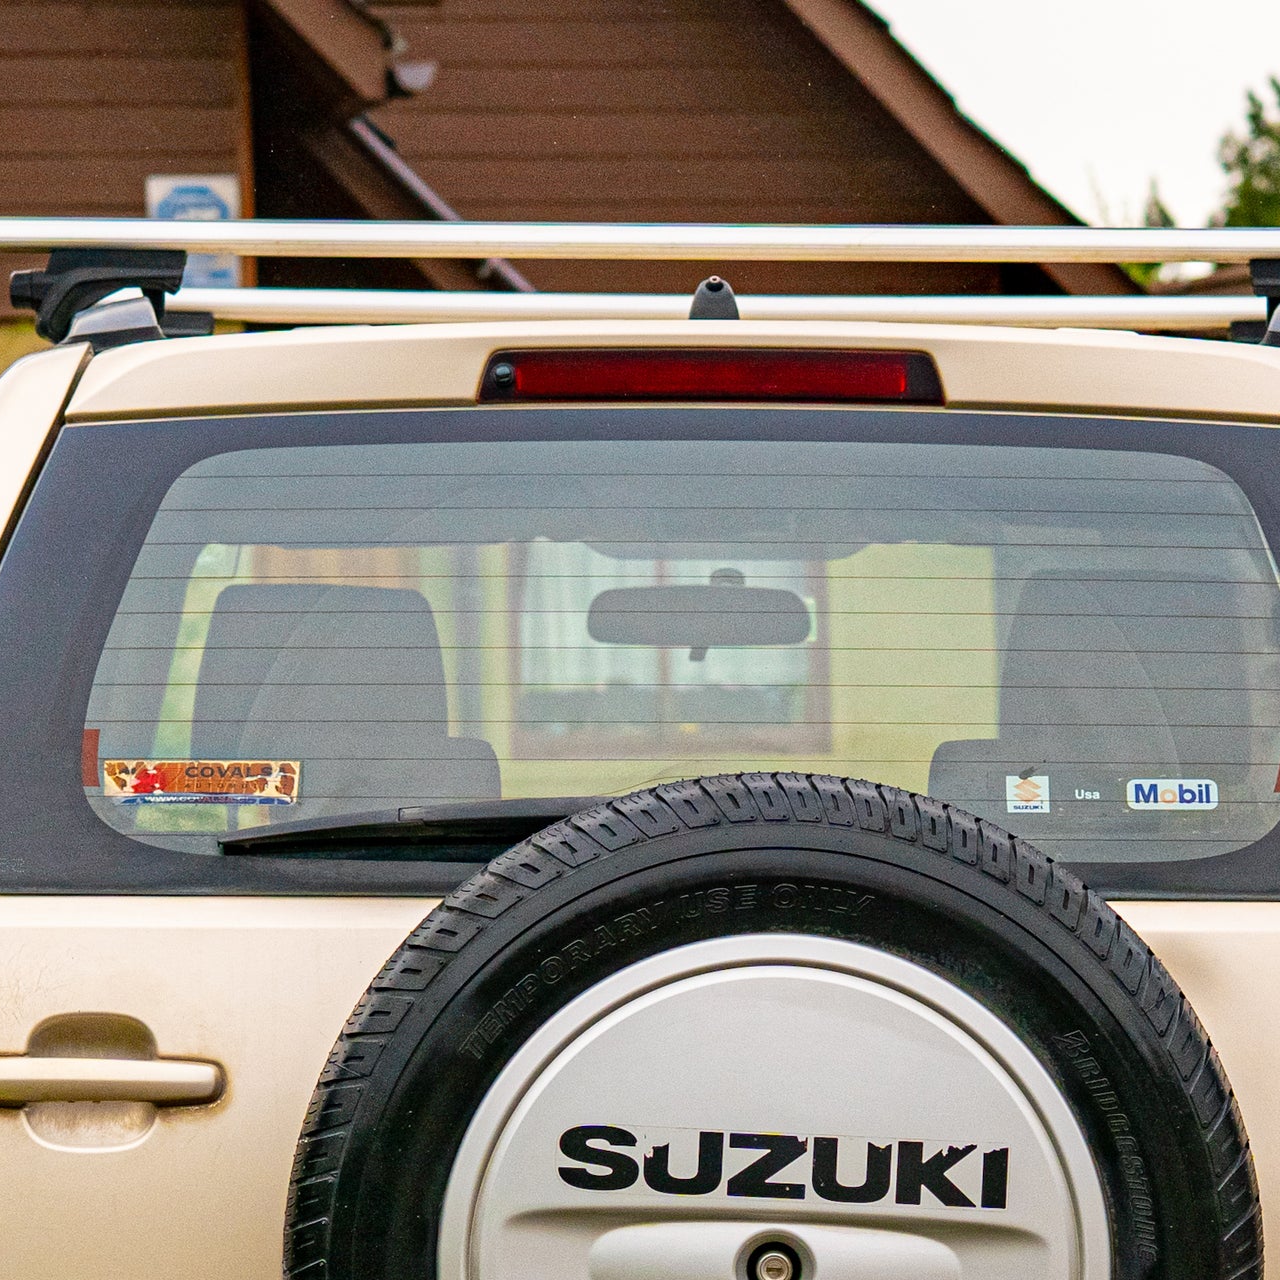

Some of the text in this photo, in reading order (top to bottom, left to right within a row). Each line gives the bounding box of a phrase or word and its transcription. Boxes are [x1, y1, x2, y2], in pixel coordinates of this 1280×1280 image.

[1074, 783, 1211, 804] Usa Mobil
[457, 901, 664, 1060] TEMPORARY
[678, 884, 758, 919] USE
[558, 1125, 1009, 1209] SUZUKI
